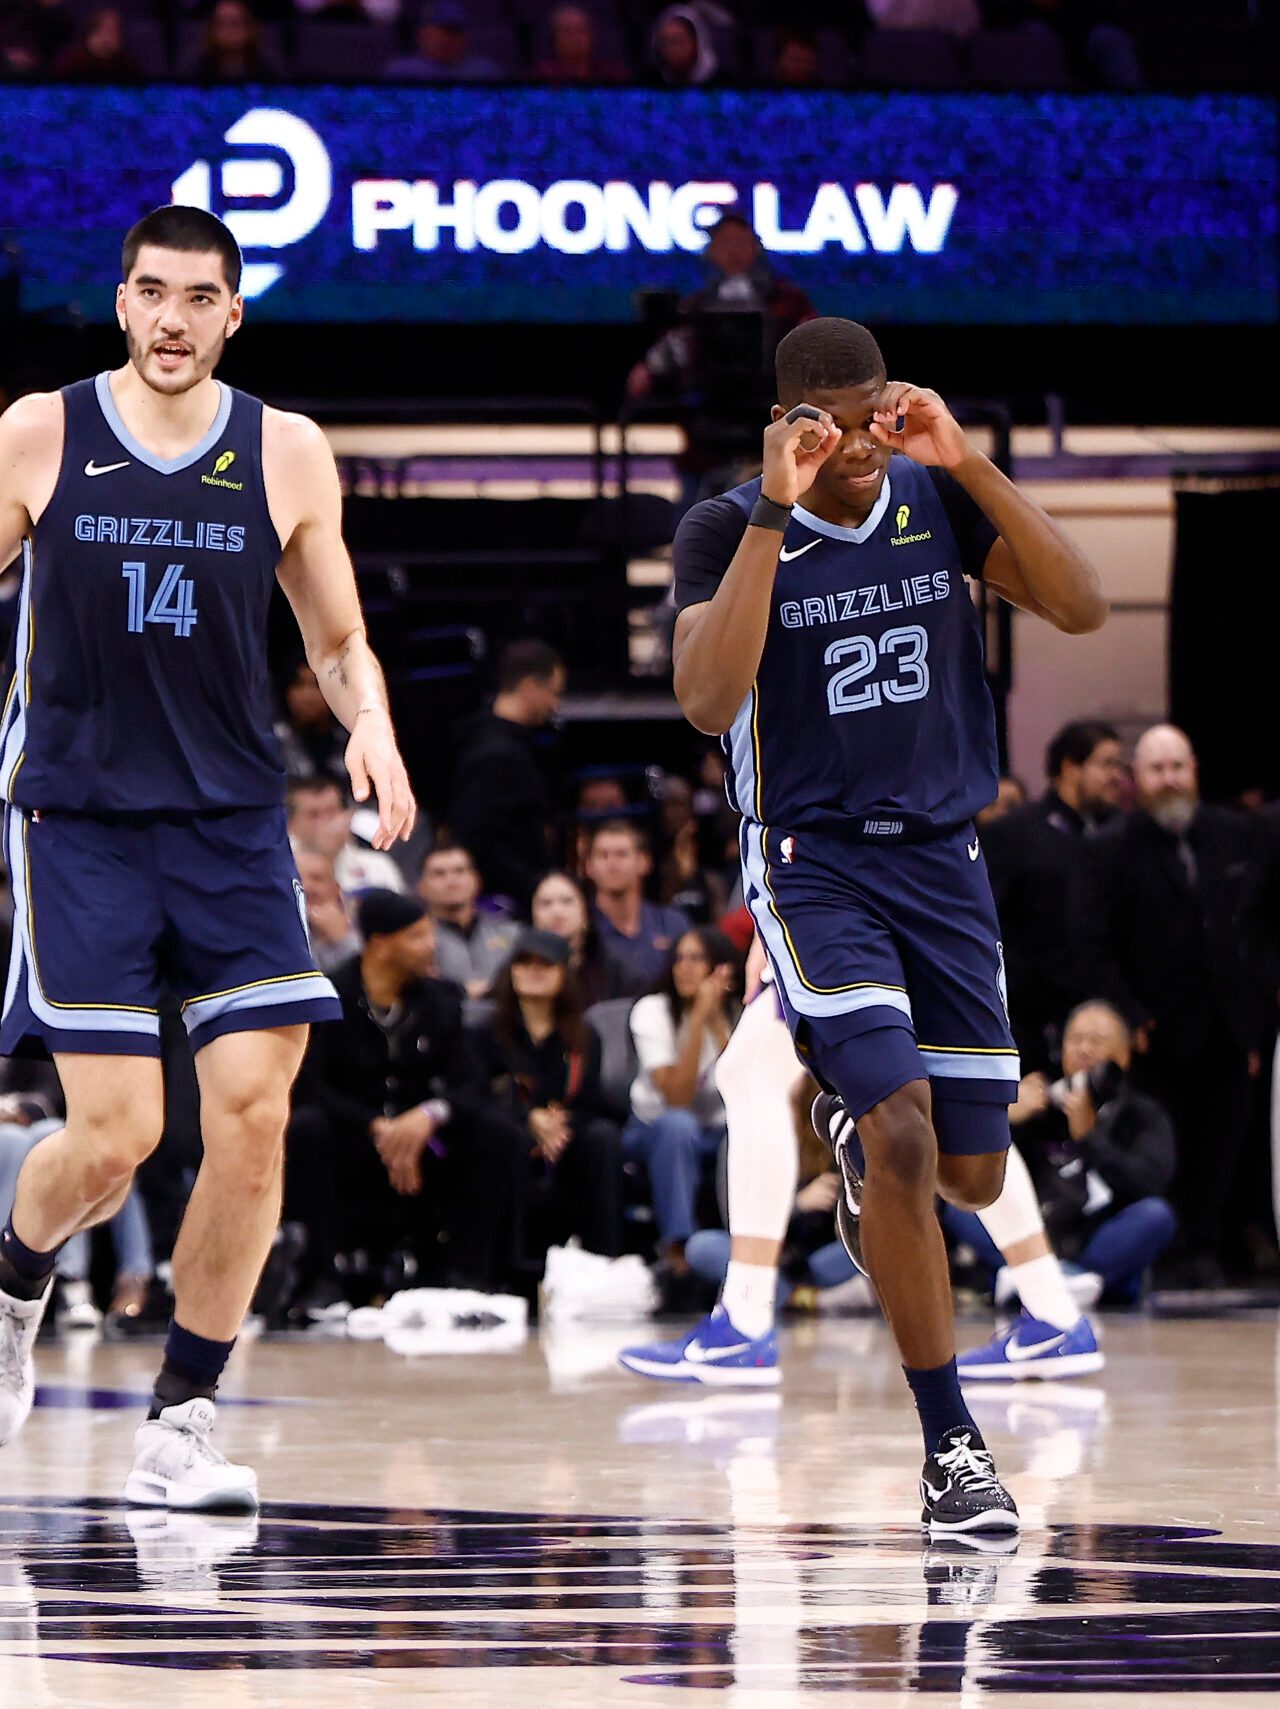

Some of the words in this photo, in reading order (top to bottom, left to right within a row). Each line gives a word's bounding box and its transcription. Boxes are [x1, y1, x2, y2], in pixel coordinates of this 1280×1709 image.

[351, 179, 738, 255] PHOONG
[753, 182, 960, 255] LAW
[201, 475, 243, 491] Robinhood
[74, 514, 246, 553] GRIZZLIES
[890, 530, 932, 547] Robinhood
[121, 561, 198, 638] 14
[779, 570, 951, 630] GRIZZLIES
[823, 624, 931, 716] 23
